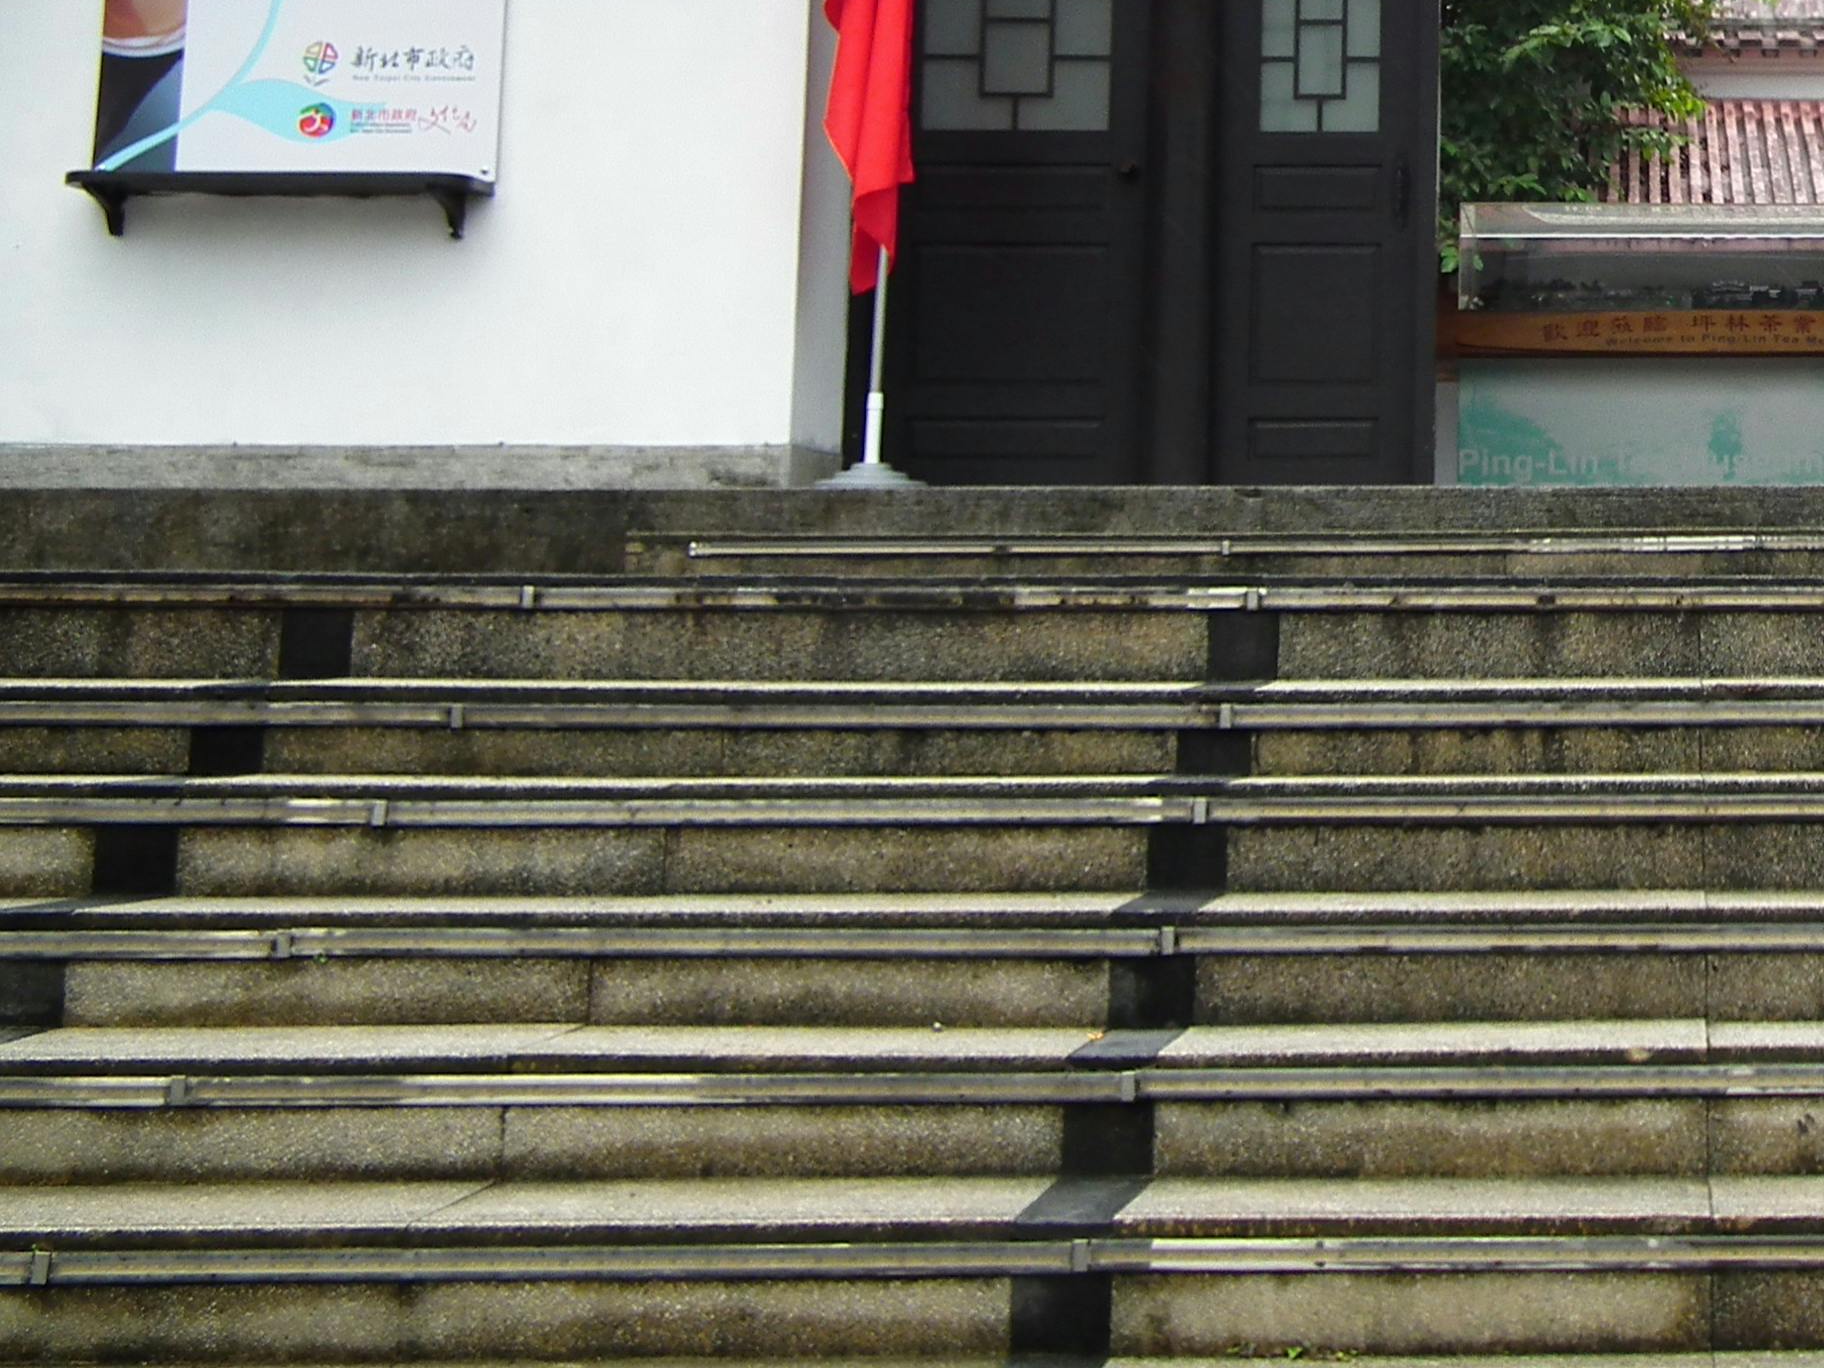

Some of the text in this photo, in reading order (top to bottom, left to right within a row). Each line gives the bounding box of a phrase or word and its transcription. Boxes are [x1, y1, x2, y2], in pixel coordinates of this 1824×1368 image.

[352, 44, 475, 72] 新北市政府
[1459, 448, 1598, 481] Ping-Lin
